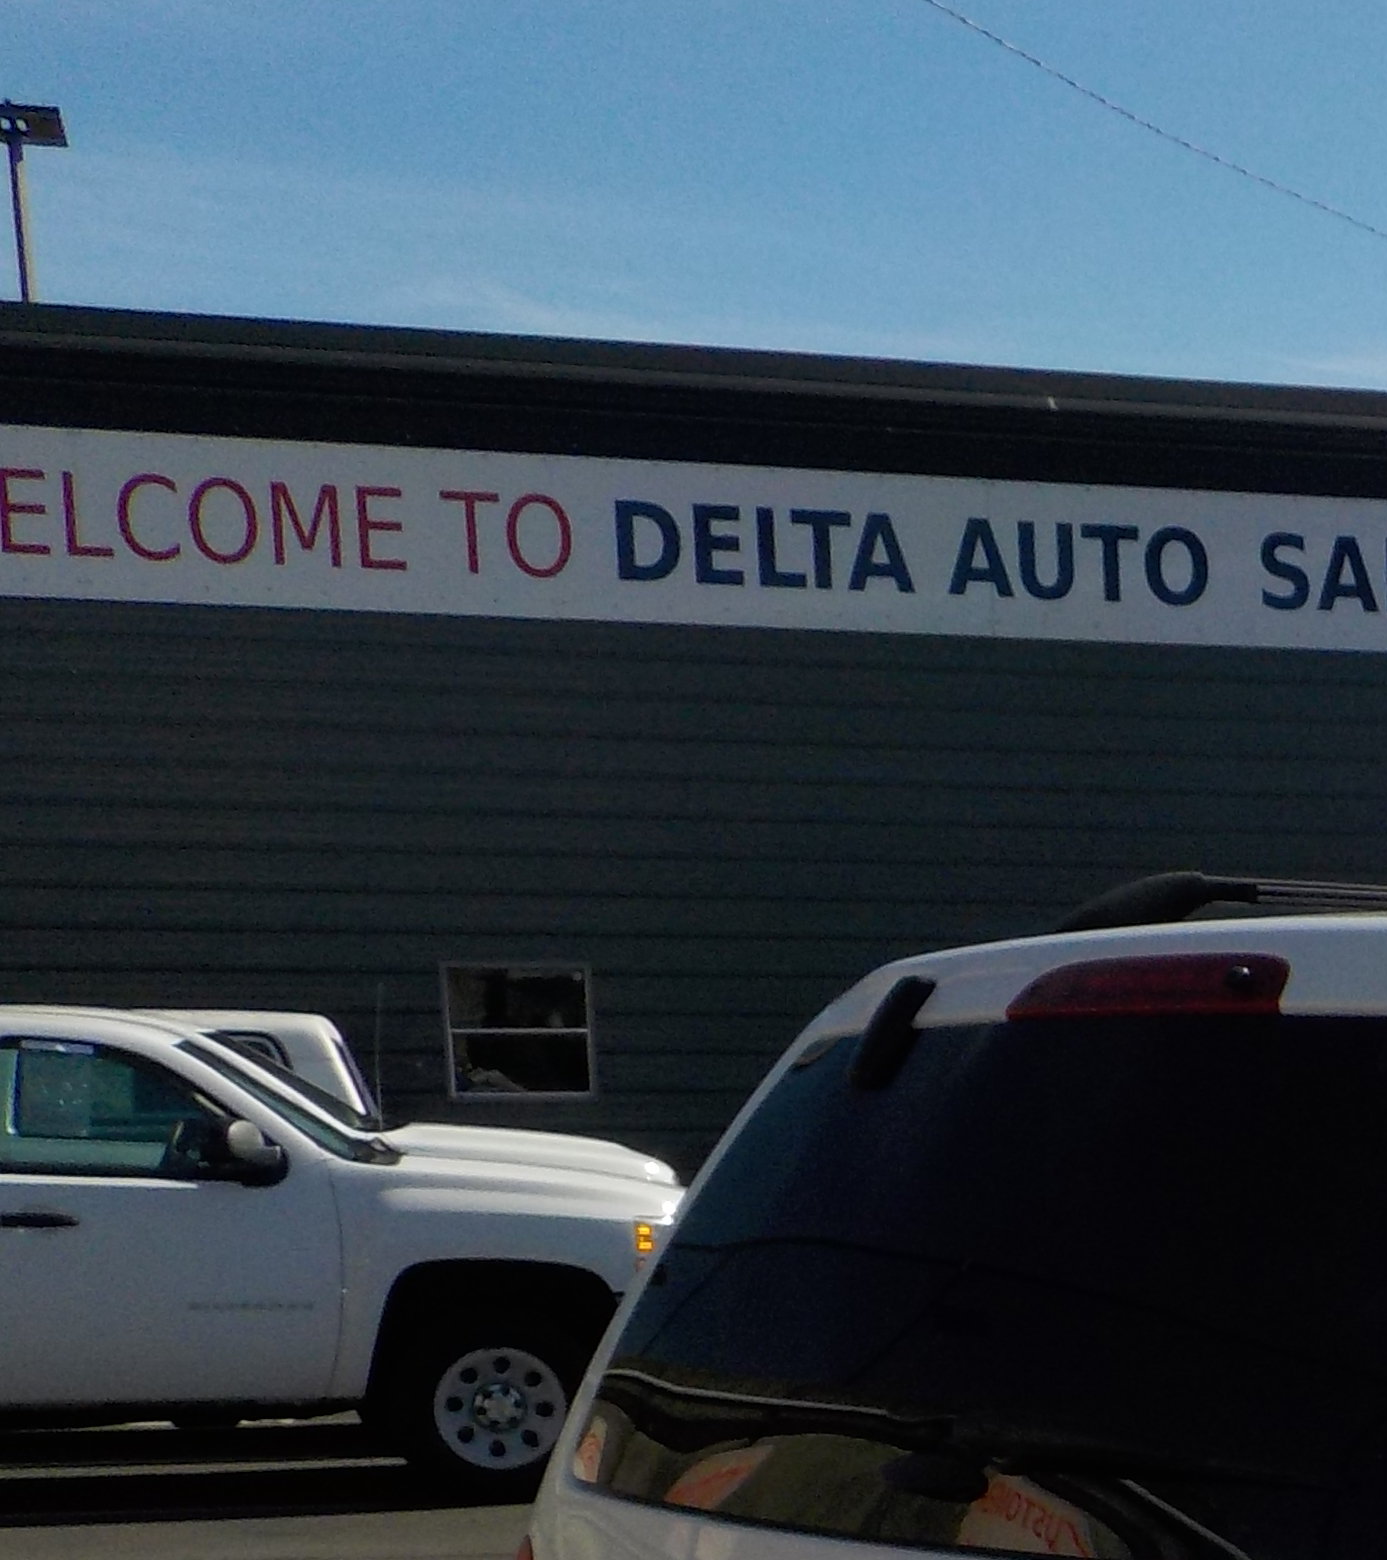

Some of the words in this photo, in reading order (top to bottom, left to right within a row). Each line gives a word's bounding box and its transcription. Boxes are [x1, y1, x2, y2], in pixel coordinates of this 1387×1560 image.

[0, 467, 408, 572] ELCOME
[439, 489, 572, 579] TO
[614, 498, 915, 594] DELTA
[949, 516, 1208, 606] AUTO
